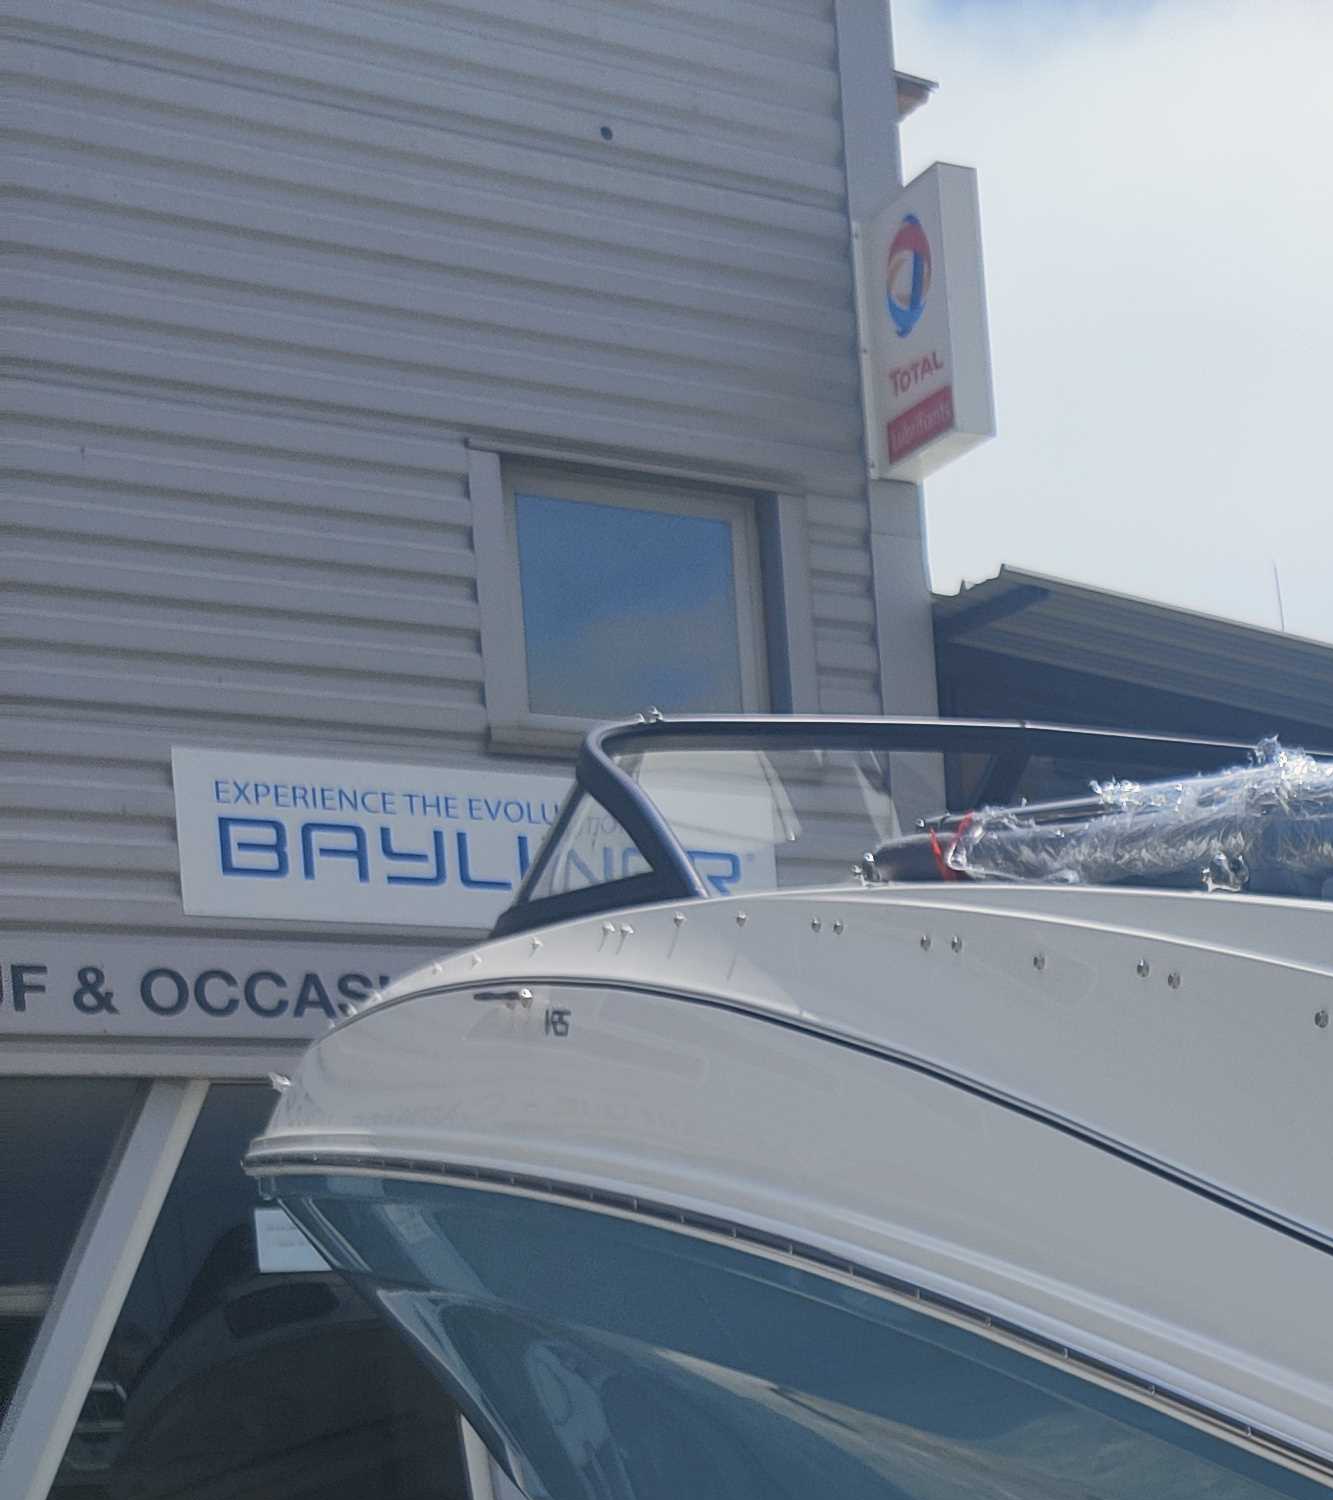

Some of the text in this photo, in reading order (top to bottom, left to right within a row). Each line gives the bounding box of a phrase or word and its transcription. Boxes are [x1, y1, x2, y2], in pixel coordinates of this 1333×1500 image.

[888, 352, 944, 397] TOTAL
[214, 779, 397, 815] EXPERIENCE
[403, 793, 459, 819] THE
[73, 965, 119, 1015] &
[140, 967, 390, 1019] OCCAS
